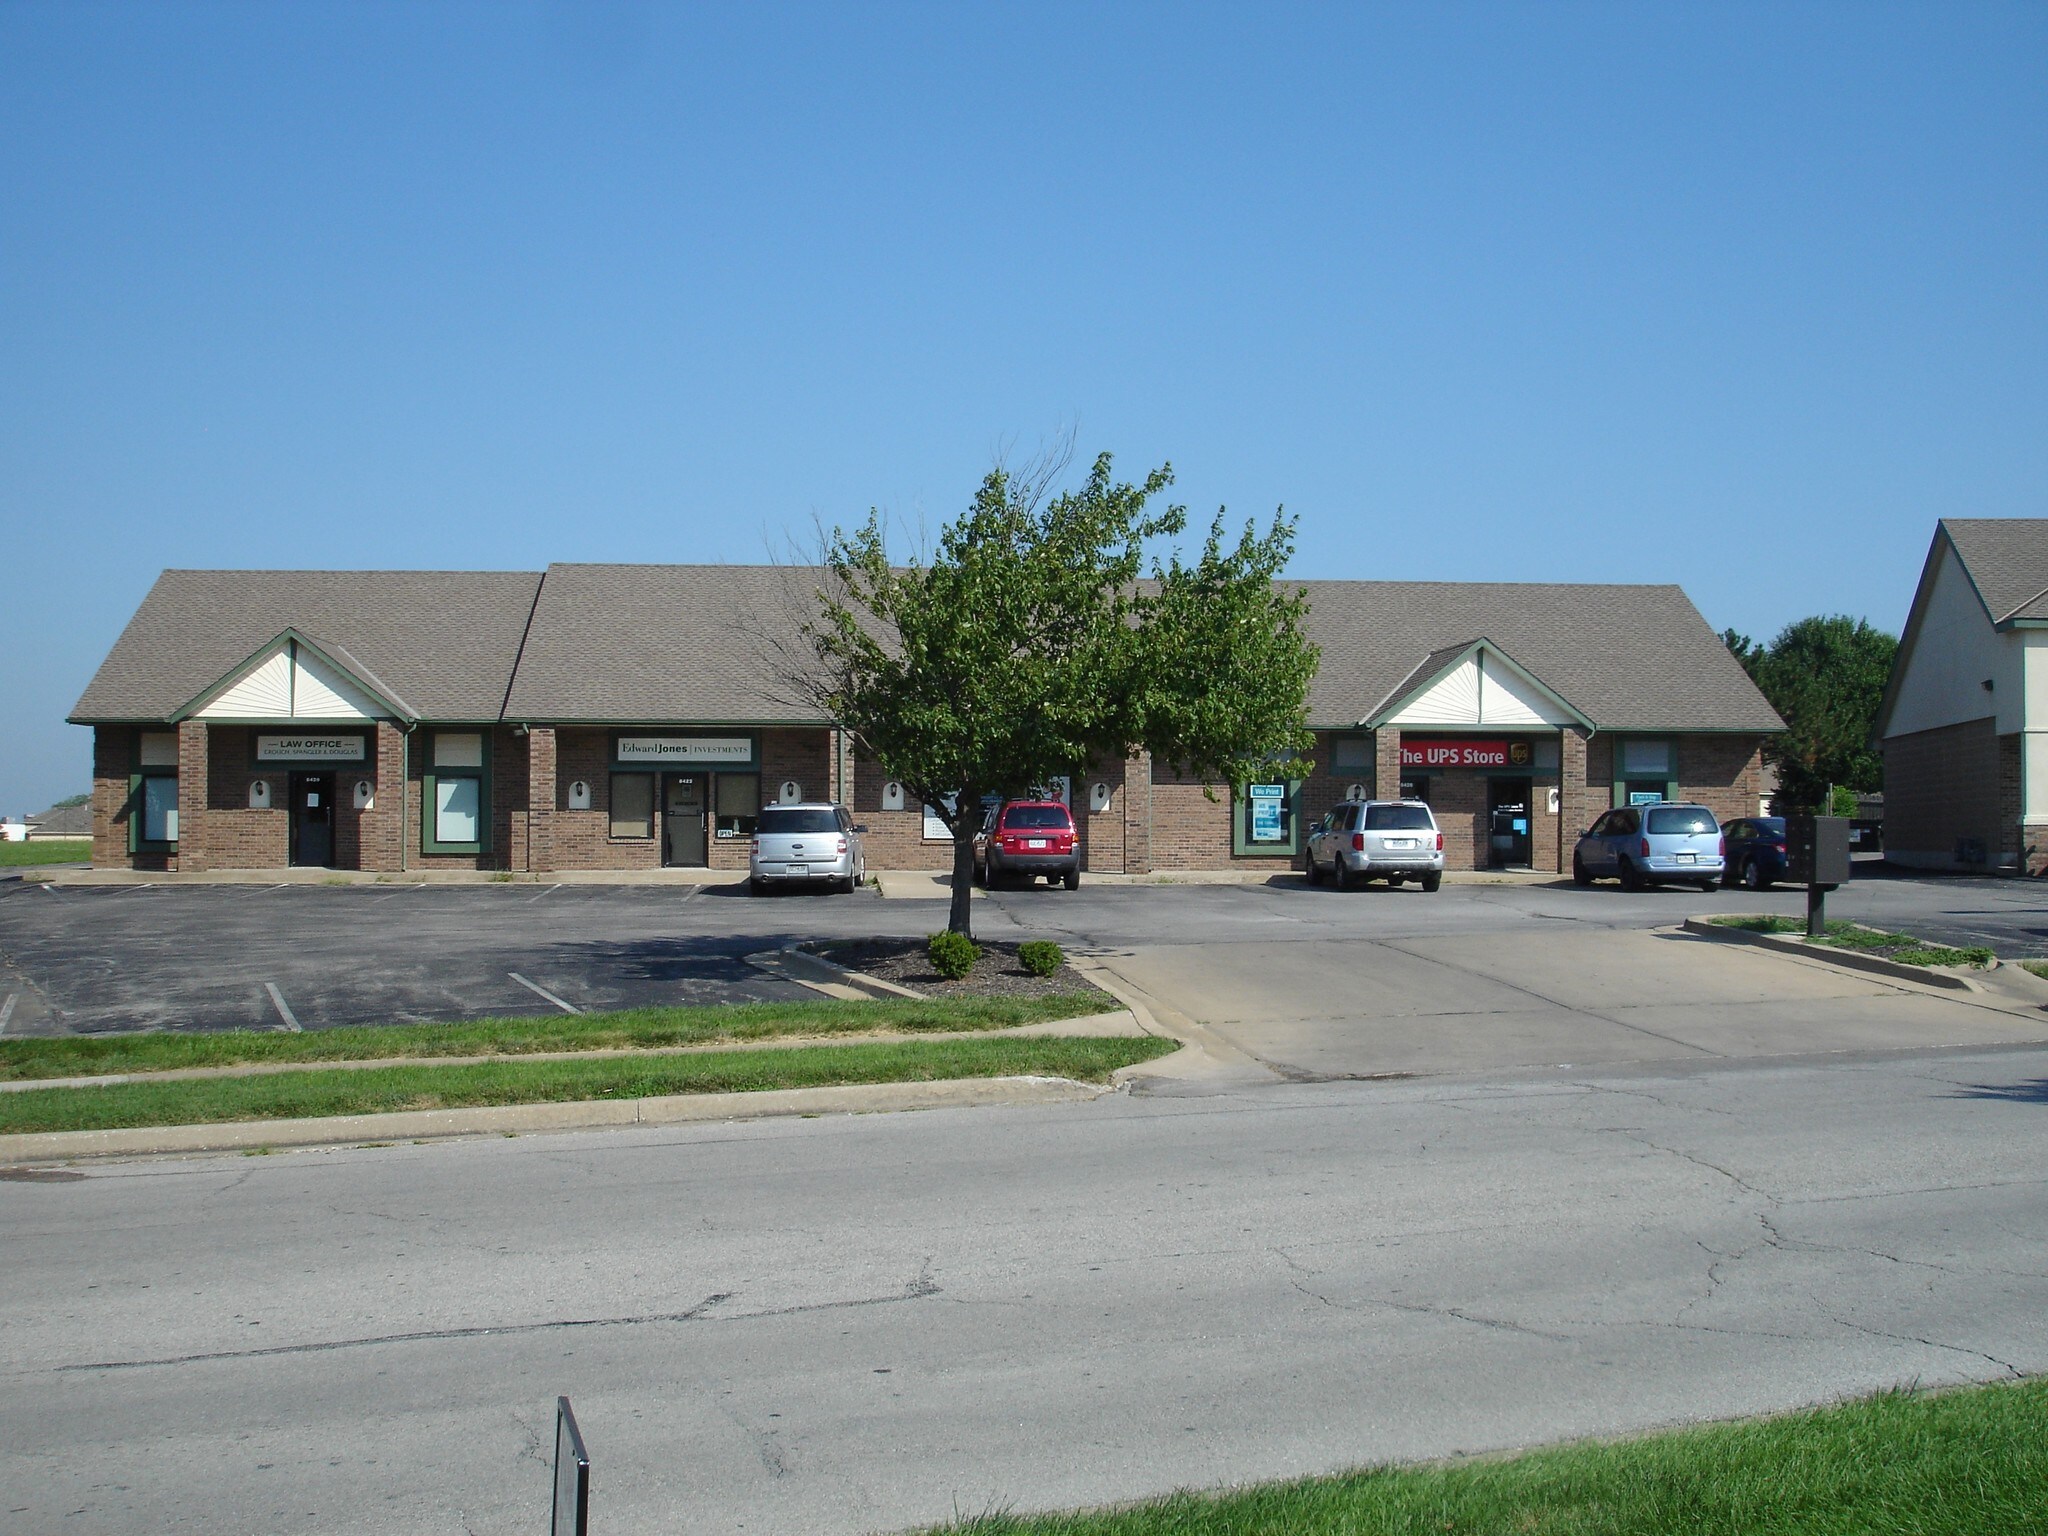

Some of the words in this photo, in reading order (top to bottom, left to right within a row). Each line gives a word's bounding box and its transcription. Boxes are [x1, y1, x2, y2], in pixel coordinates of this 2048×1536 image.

[280, 740, 302, 748] LAW
[304, 740, 342, 748] OFFICE
[1400, 748, 1423, 764] he
[1427, 748, 1459, 764] UPS
[1463, 748, 1504, 764] Store
